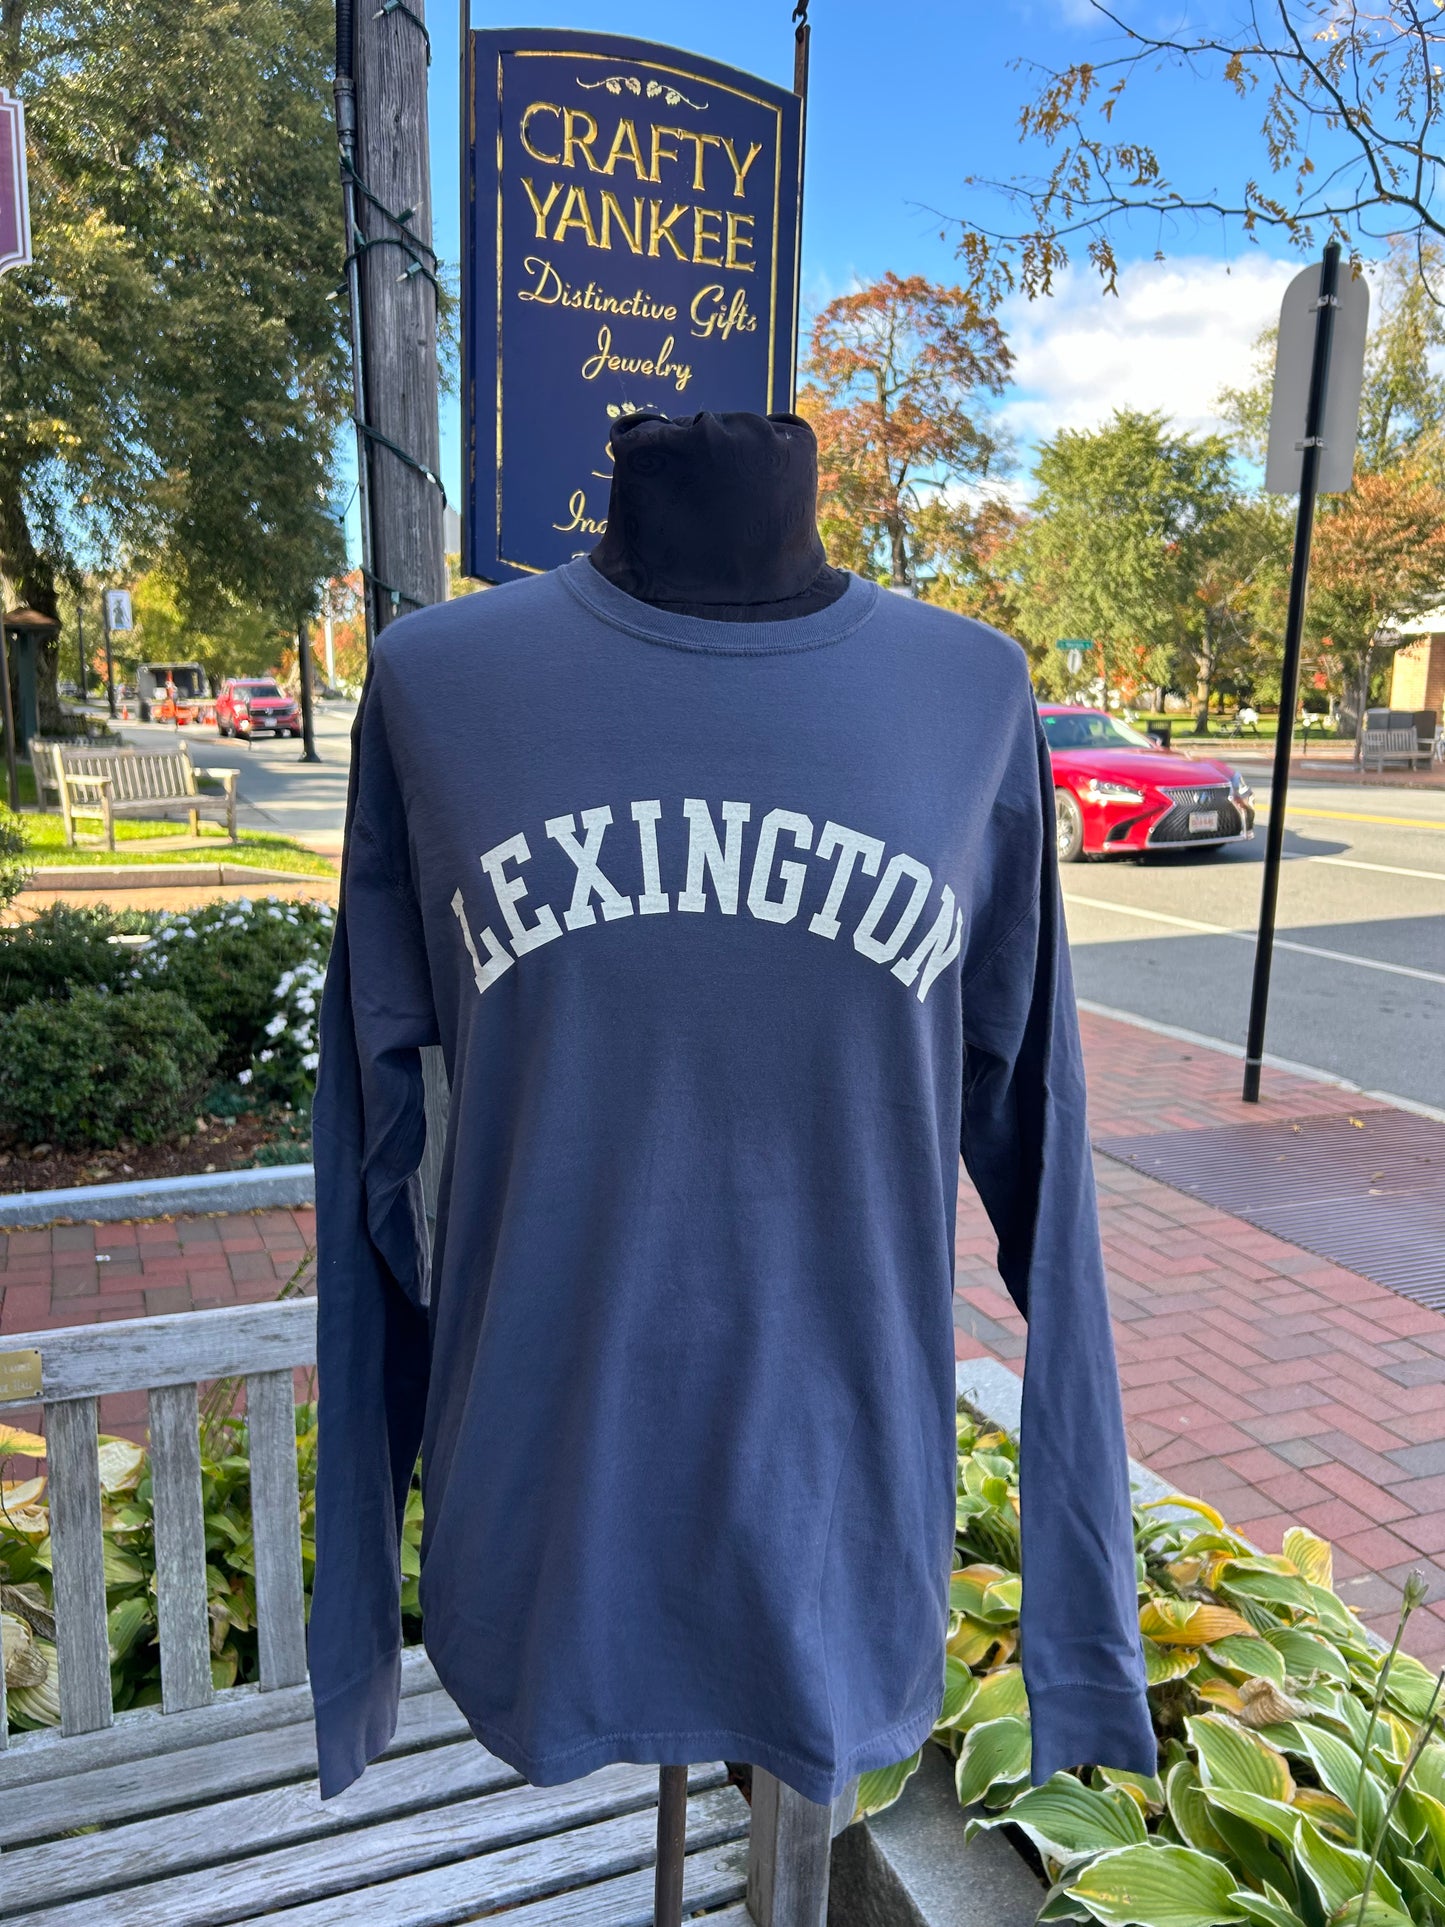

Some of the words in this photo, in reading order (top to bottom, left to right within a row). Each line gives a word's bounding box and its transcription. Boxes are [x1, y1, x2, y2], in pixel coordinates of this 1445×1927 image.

[520, 101, 762, 198] CRAFTY
[520, 177, 757, 272] YANKEE
[517, 256, 678, 321] Distinctive
[690, 284, 757, 340] Gifts
[581, 324, 693, 391] Jewelry
[450, 798, 963, 1003] LEXINGTON
